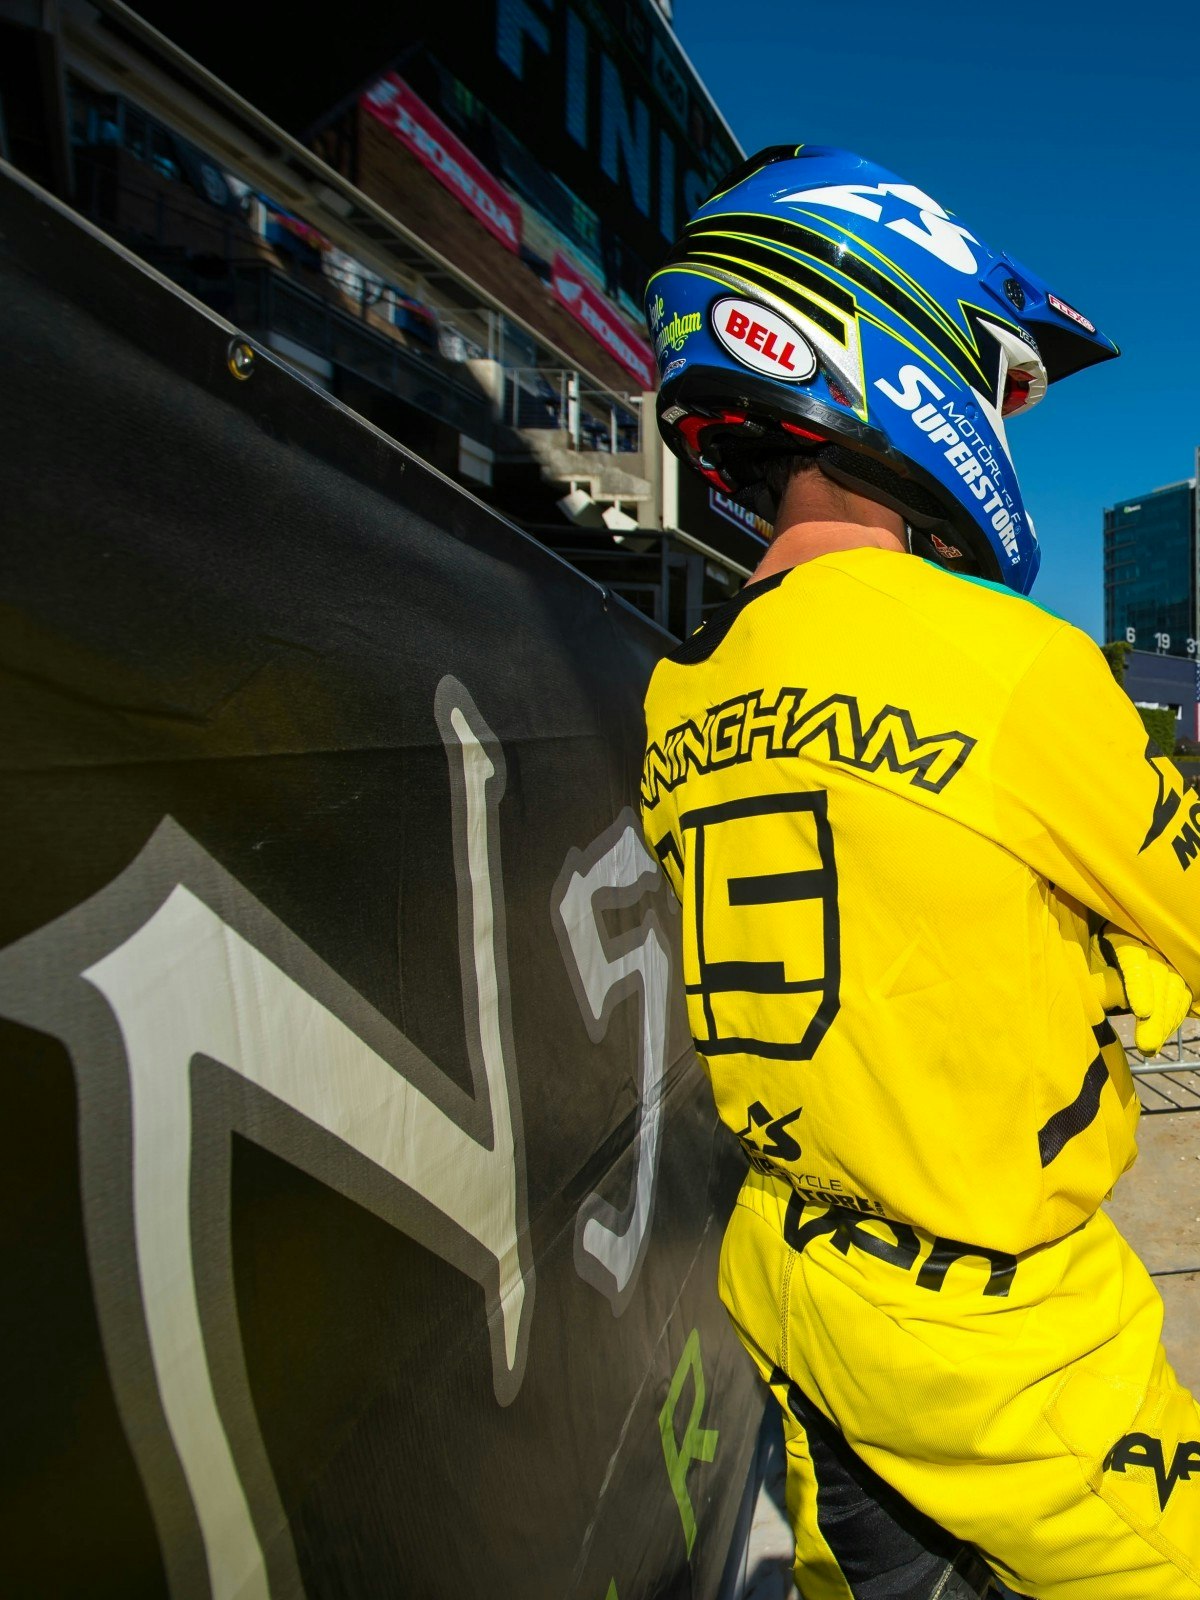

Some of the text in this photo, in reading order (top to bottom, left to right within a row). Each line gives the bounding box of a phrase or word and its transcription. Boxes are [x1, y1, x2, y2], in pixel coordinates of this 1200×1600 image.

[725, 309, 797, 372] BELL
[873, 364, 1019, 559] SUPERSTORE
[1126, 627, 1136, 644] 6
[1154, 632, 1171, 649] 19
